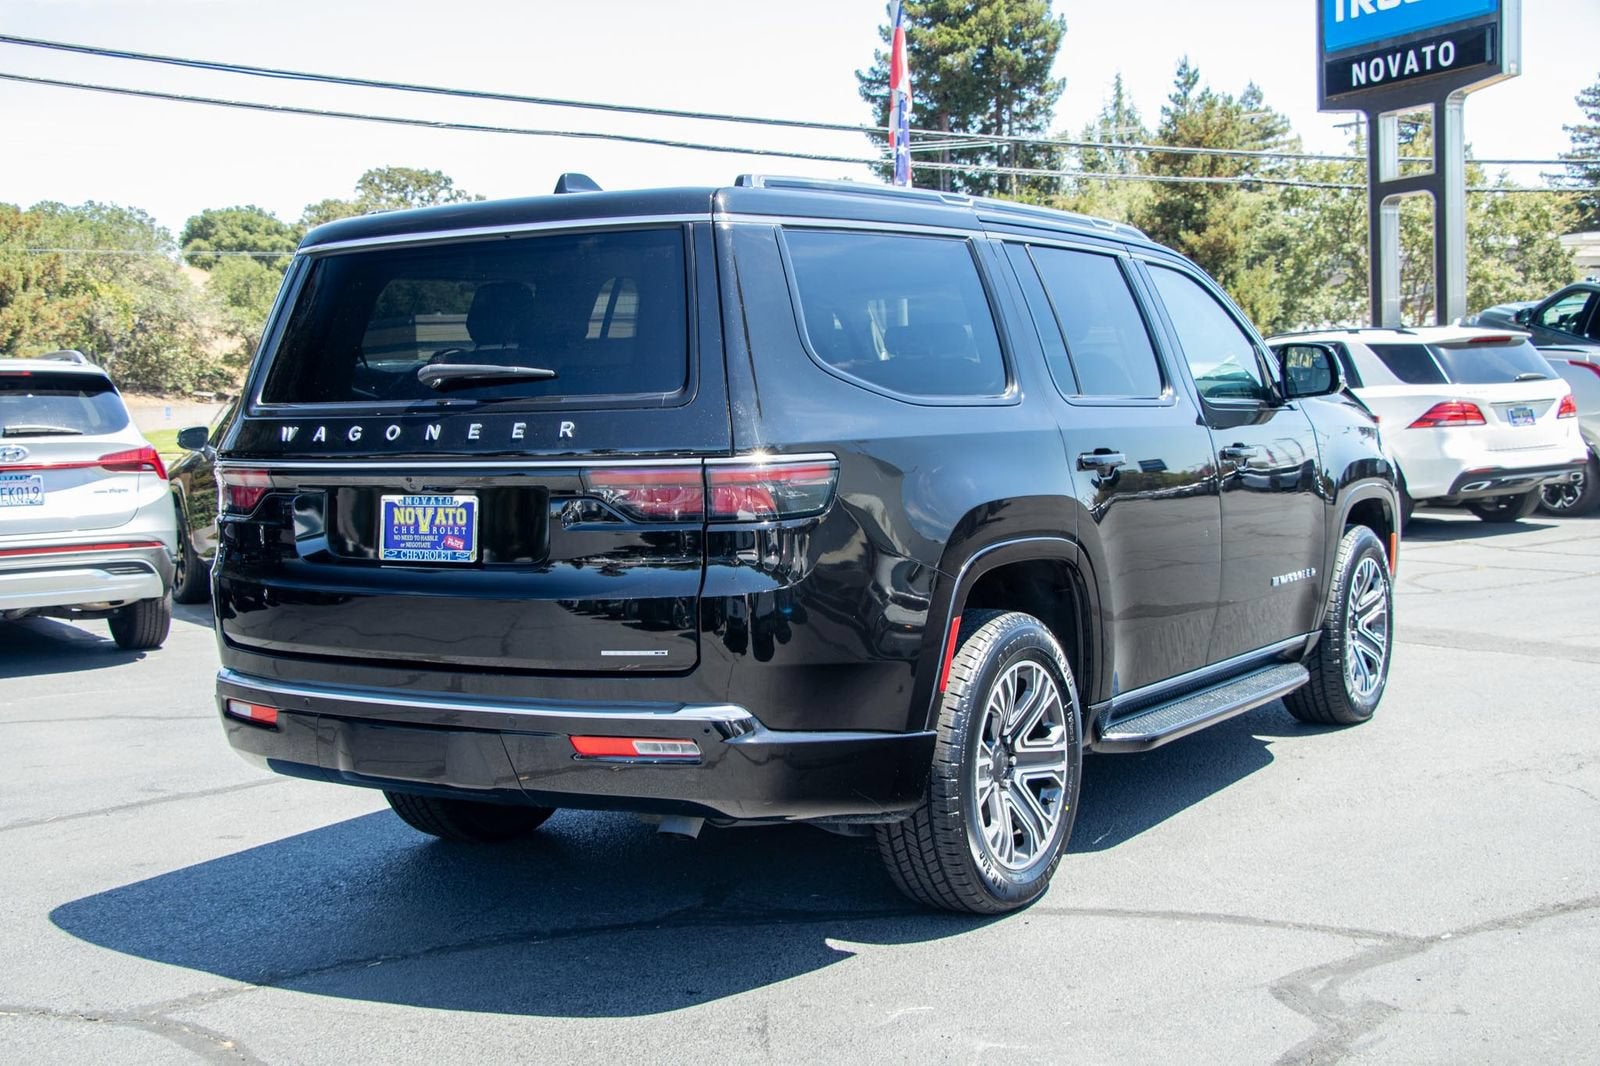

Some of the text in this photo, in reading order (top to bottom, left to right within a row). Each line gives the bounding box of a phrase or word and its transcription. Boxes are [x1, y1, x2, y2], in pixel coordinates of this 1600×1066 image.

[1351, 41, 1456, 87] NOVATO
[281, 421, 575, 442] WAGONEER
[405, 496, 452, 506] NOVATO
[393, 507, 467, 534] NOVATO
[400, 550, 452, 560] CHEVROLET
